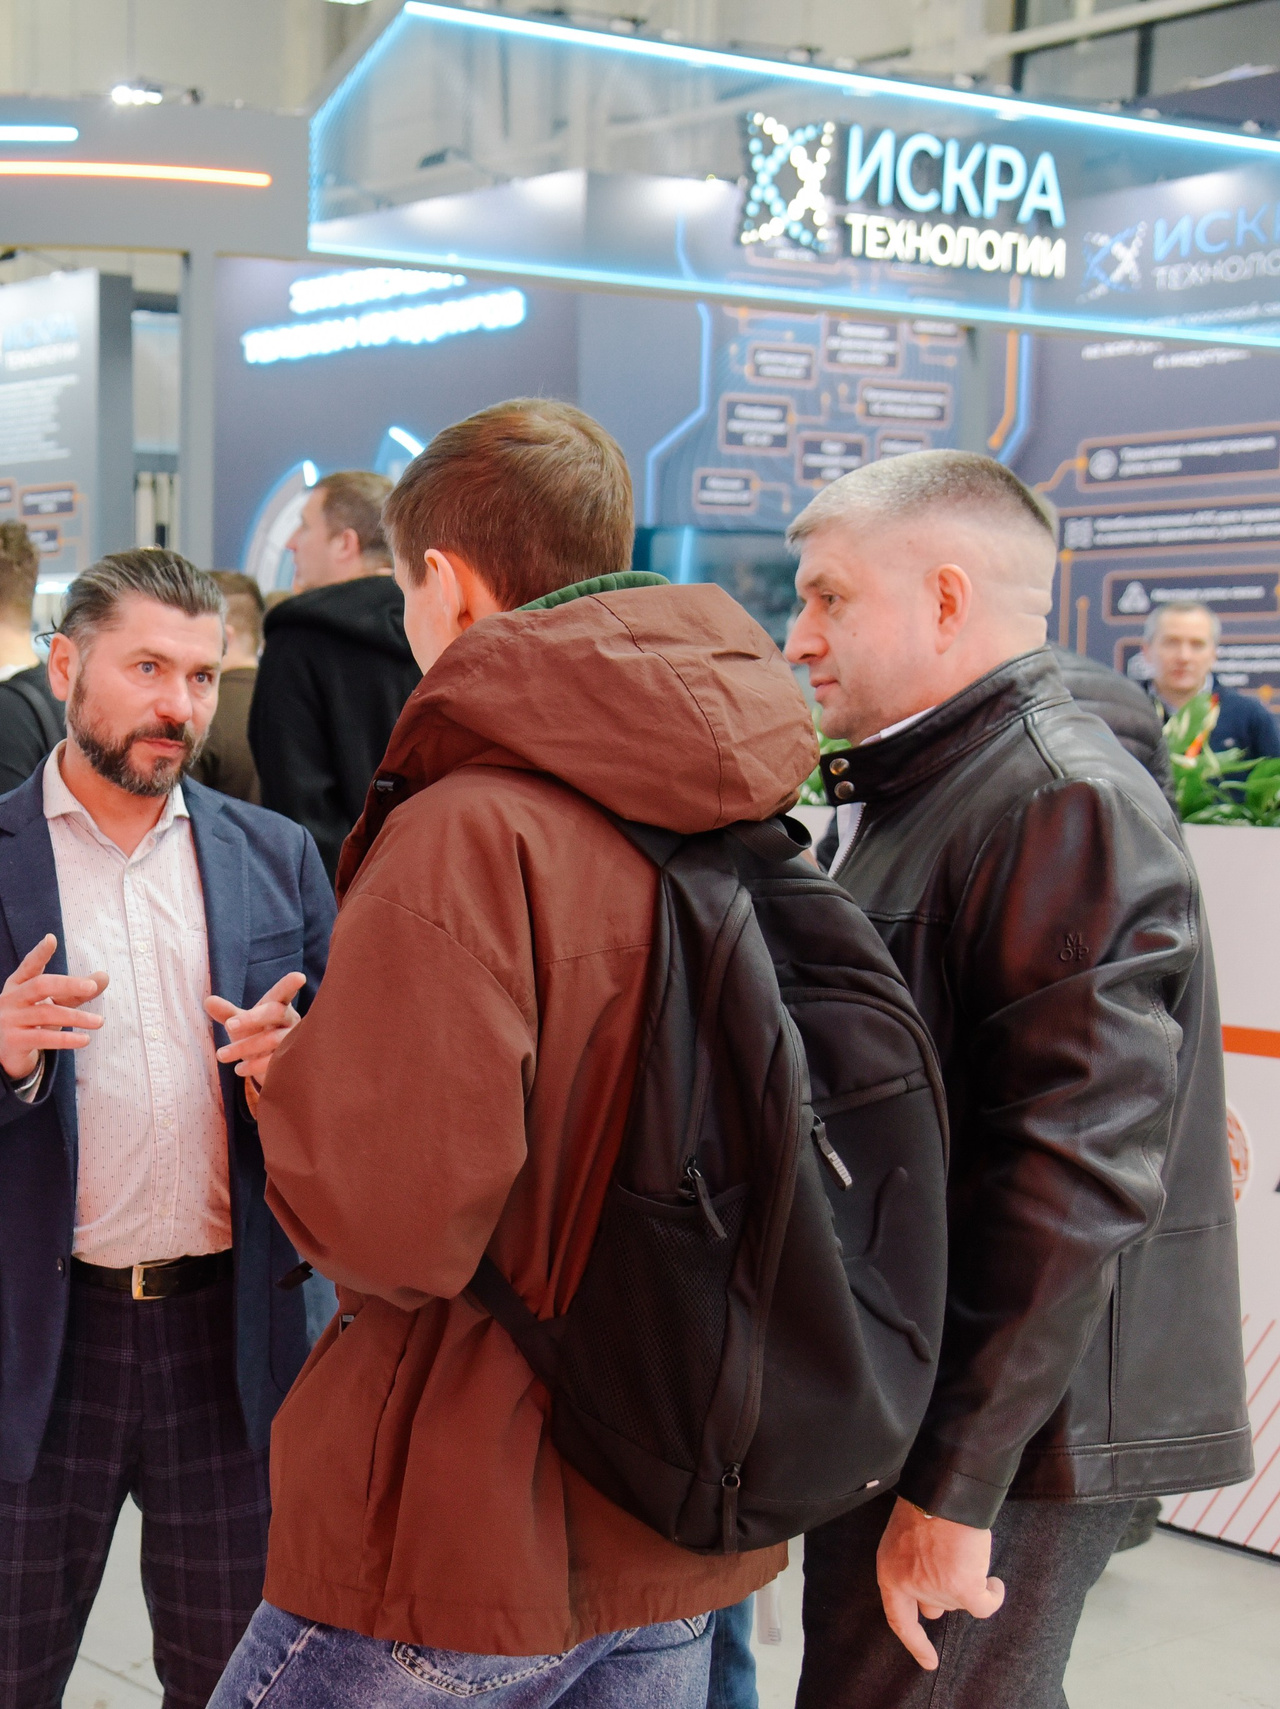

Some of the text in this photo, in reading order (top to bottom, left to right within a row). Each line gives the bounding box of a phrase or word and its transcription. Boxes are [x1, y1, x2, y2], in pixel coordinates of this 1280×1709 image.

[845, 123, 1066, 229] ИСКРА
[844, 212, 1067, 280] ТЕХНОЛОГИИ
[1153, 203, 1280, 263] ИСК
